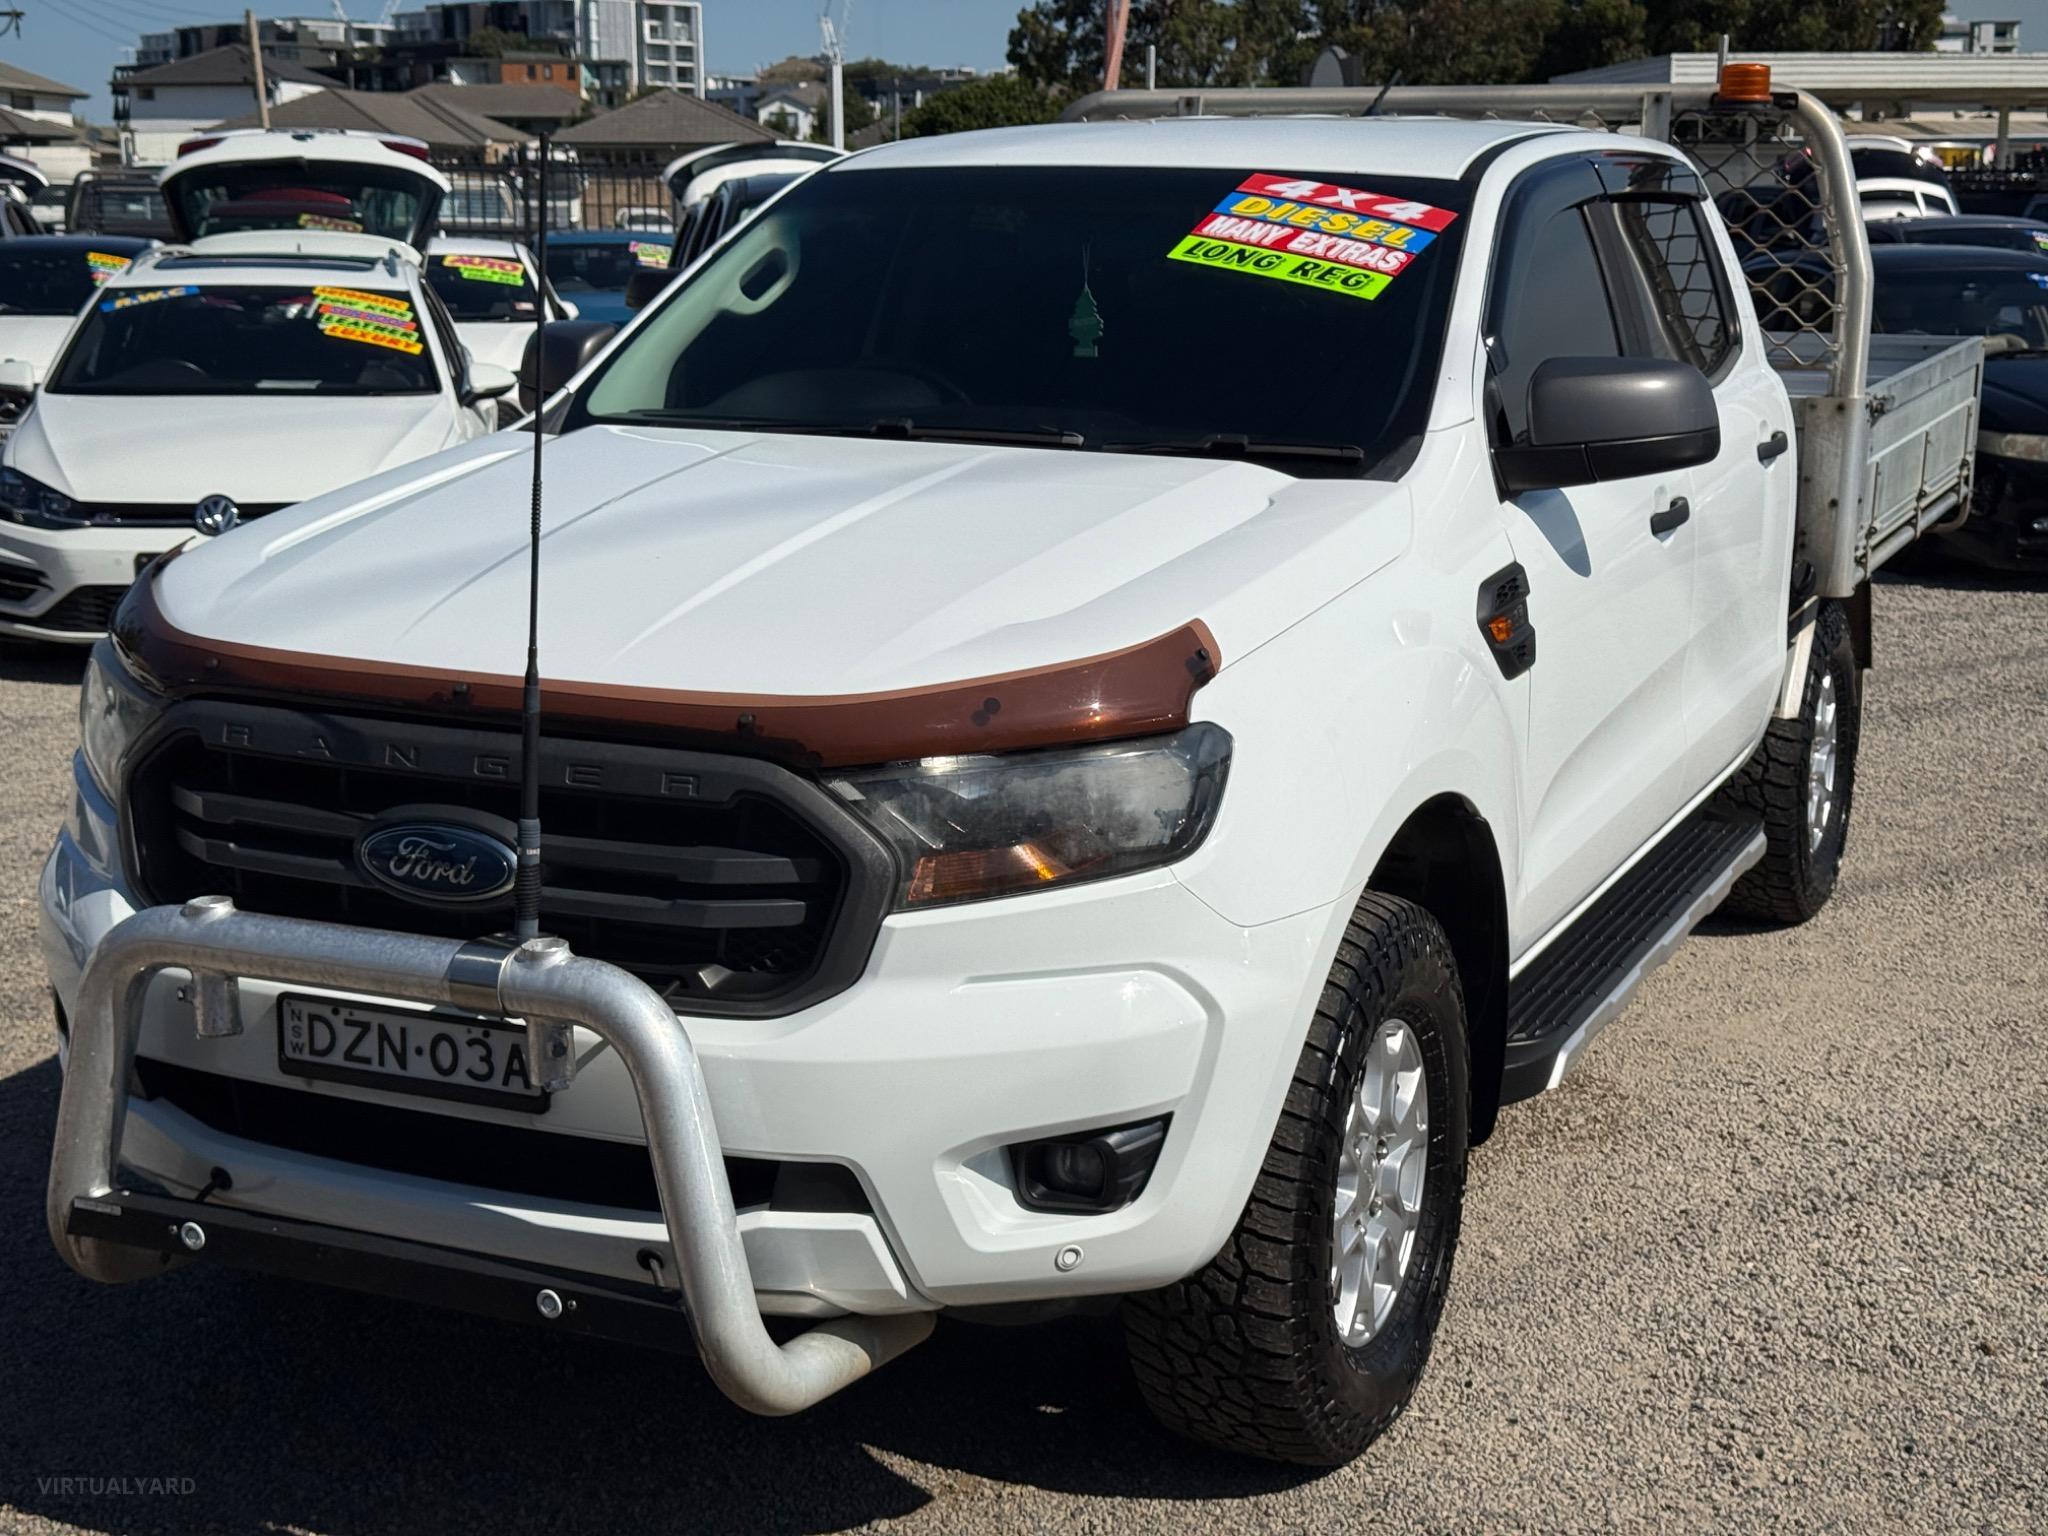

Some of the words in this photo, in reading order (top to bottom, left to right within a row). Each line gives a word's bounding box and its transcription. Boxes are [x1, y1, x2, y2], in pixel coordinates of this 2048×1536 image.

[1230, 196, 1416, 249] DIESEL
[1265, 179, 1429, 222] 4X4
[448, 256, 520, 272] AUTO
[1183, 240, 1286, 270] LONG
[1288, 261, 1375, 290] REG
[1202, 215, 1293, 246] MANY
[1287, 230, 1408, 272] EXTRAS
[322, 314, 415, 339] LEATHER
[327, 325, 417, 349] LUXURY
[221, 722, 699, 797] RANGER
[389, 836, 478, 885] Ford
